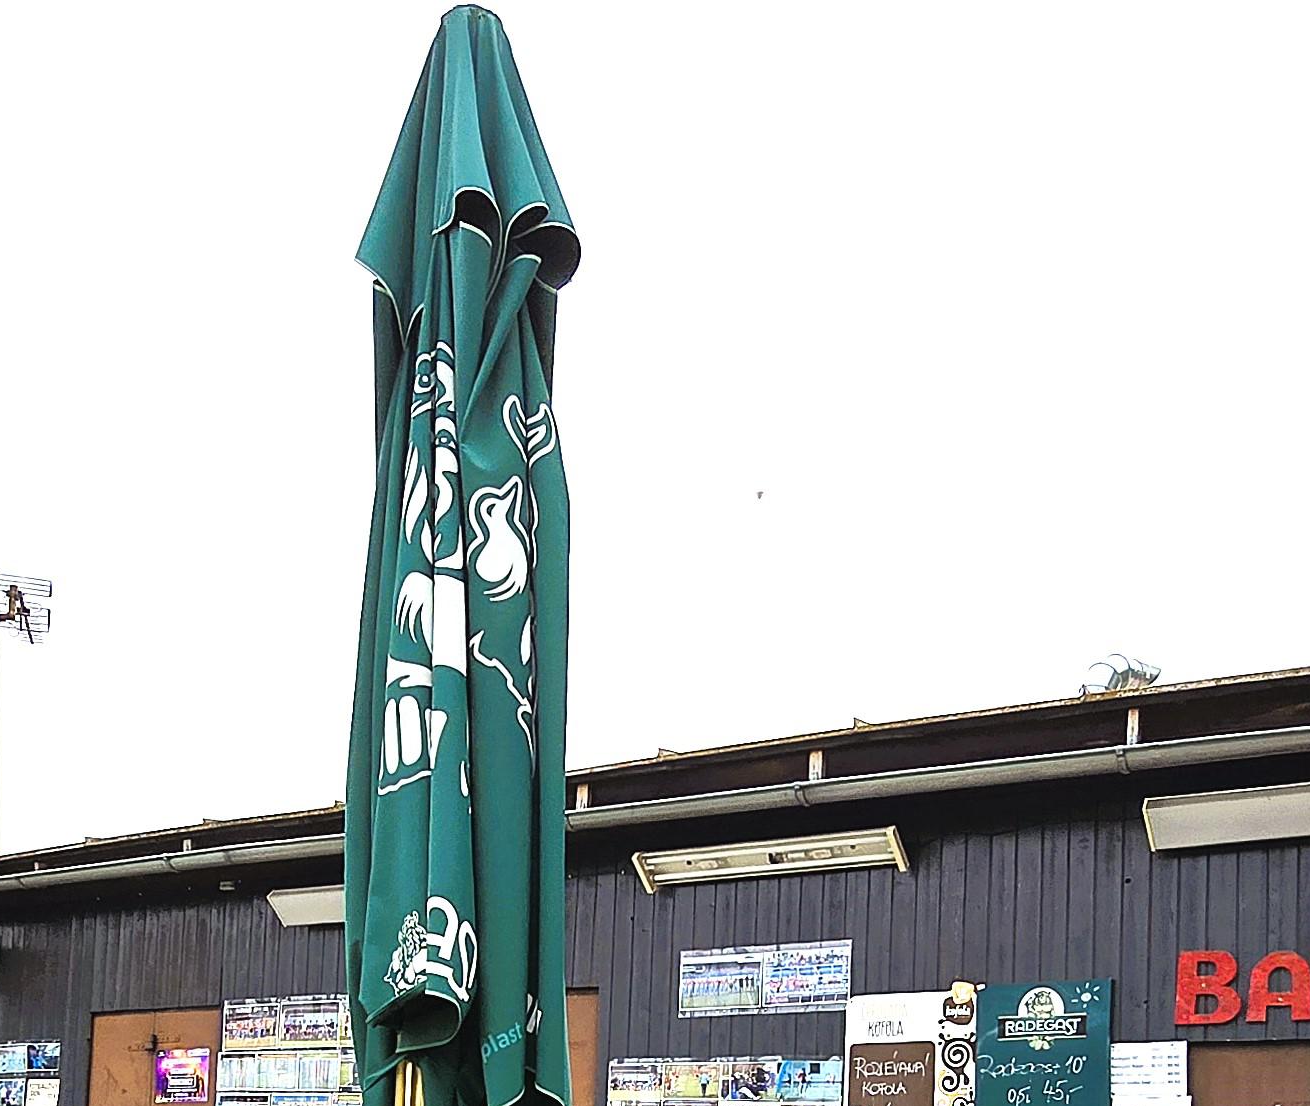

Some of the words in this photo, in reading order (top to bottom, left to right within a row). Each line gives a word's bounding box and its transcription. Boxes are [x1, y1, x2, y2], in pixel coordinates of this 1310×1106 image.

[868, 1020, 904, 1037] KOFOLA
[1004, 1017, 1082, 1037] RADEGAST
[862, 1081, 907, 1097] KOFOLA
